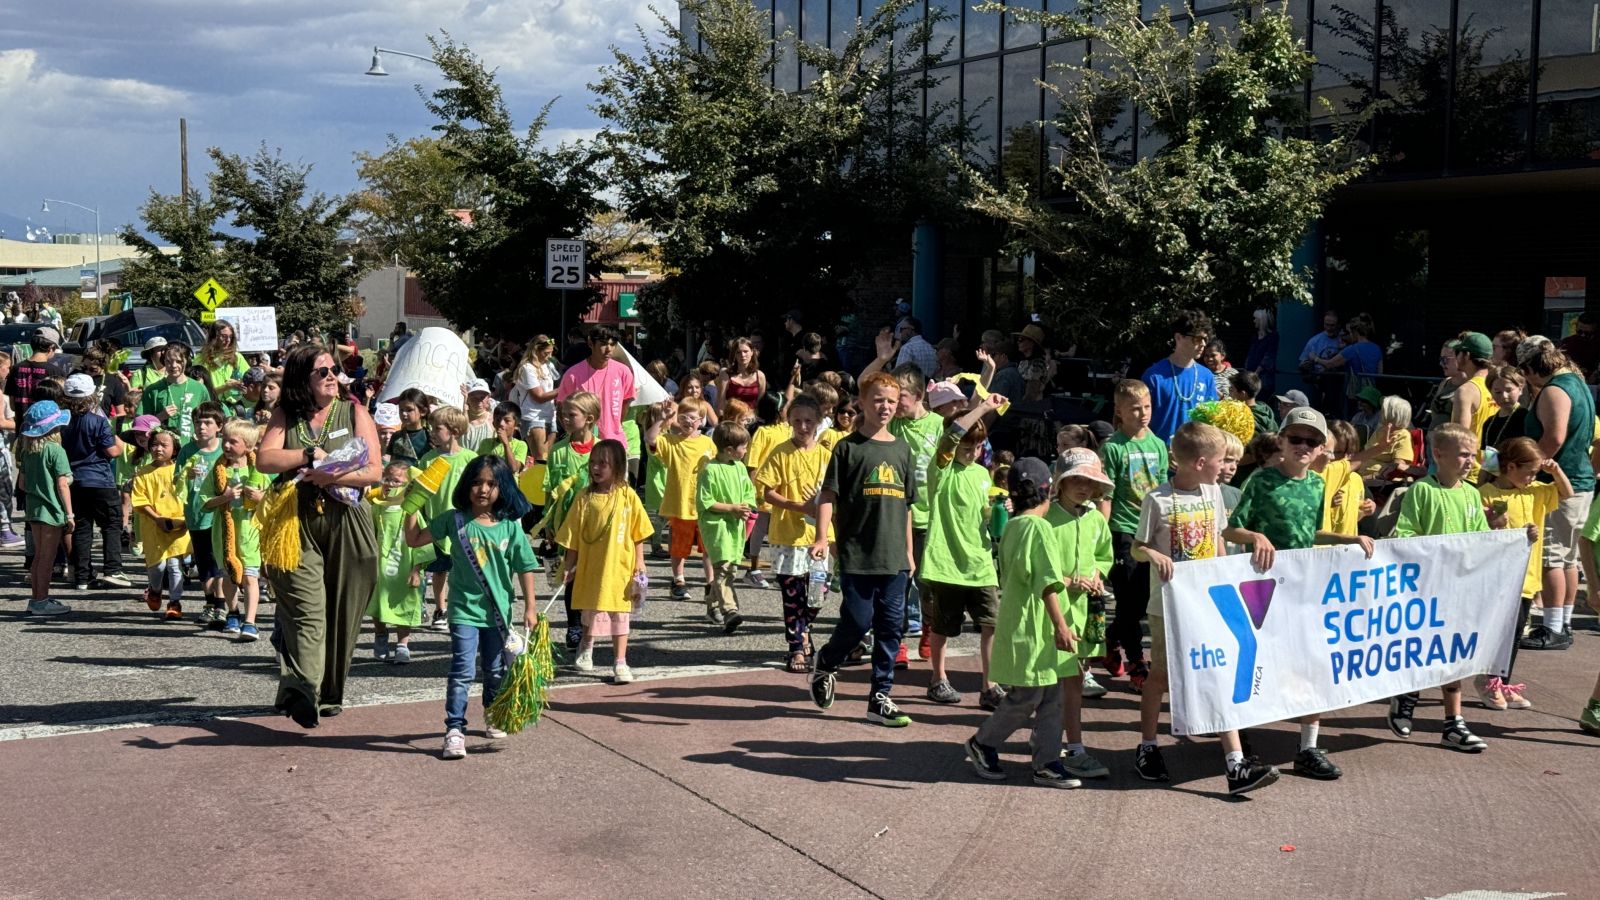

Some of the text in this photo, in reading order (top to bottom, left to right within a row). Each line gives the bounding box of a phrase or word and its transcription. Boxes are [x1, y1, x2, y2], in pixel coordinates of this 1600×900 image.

[550, 243, 582, 253] SPEED
[552, 254, 579, 263] LIMIT
[550, 265, 581, 284] 25
[611, 389, 620, 417] STAFF
[181, 406, 193, 438] STAFF
[1321, 562, 1421, 605] AFTER
[1323, 597, 1446, 645] SCHOOL
[1189, 643, 1226, 670] the
[1330, 631, 1479, 685] PROGRAM
[1253, 665, 1263, 696] YMCA
